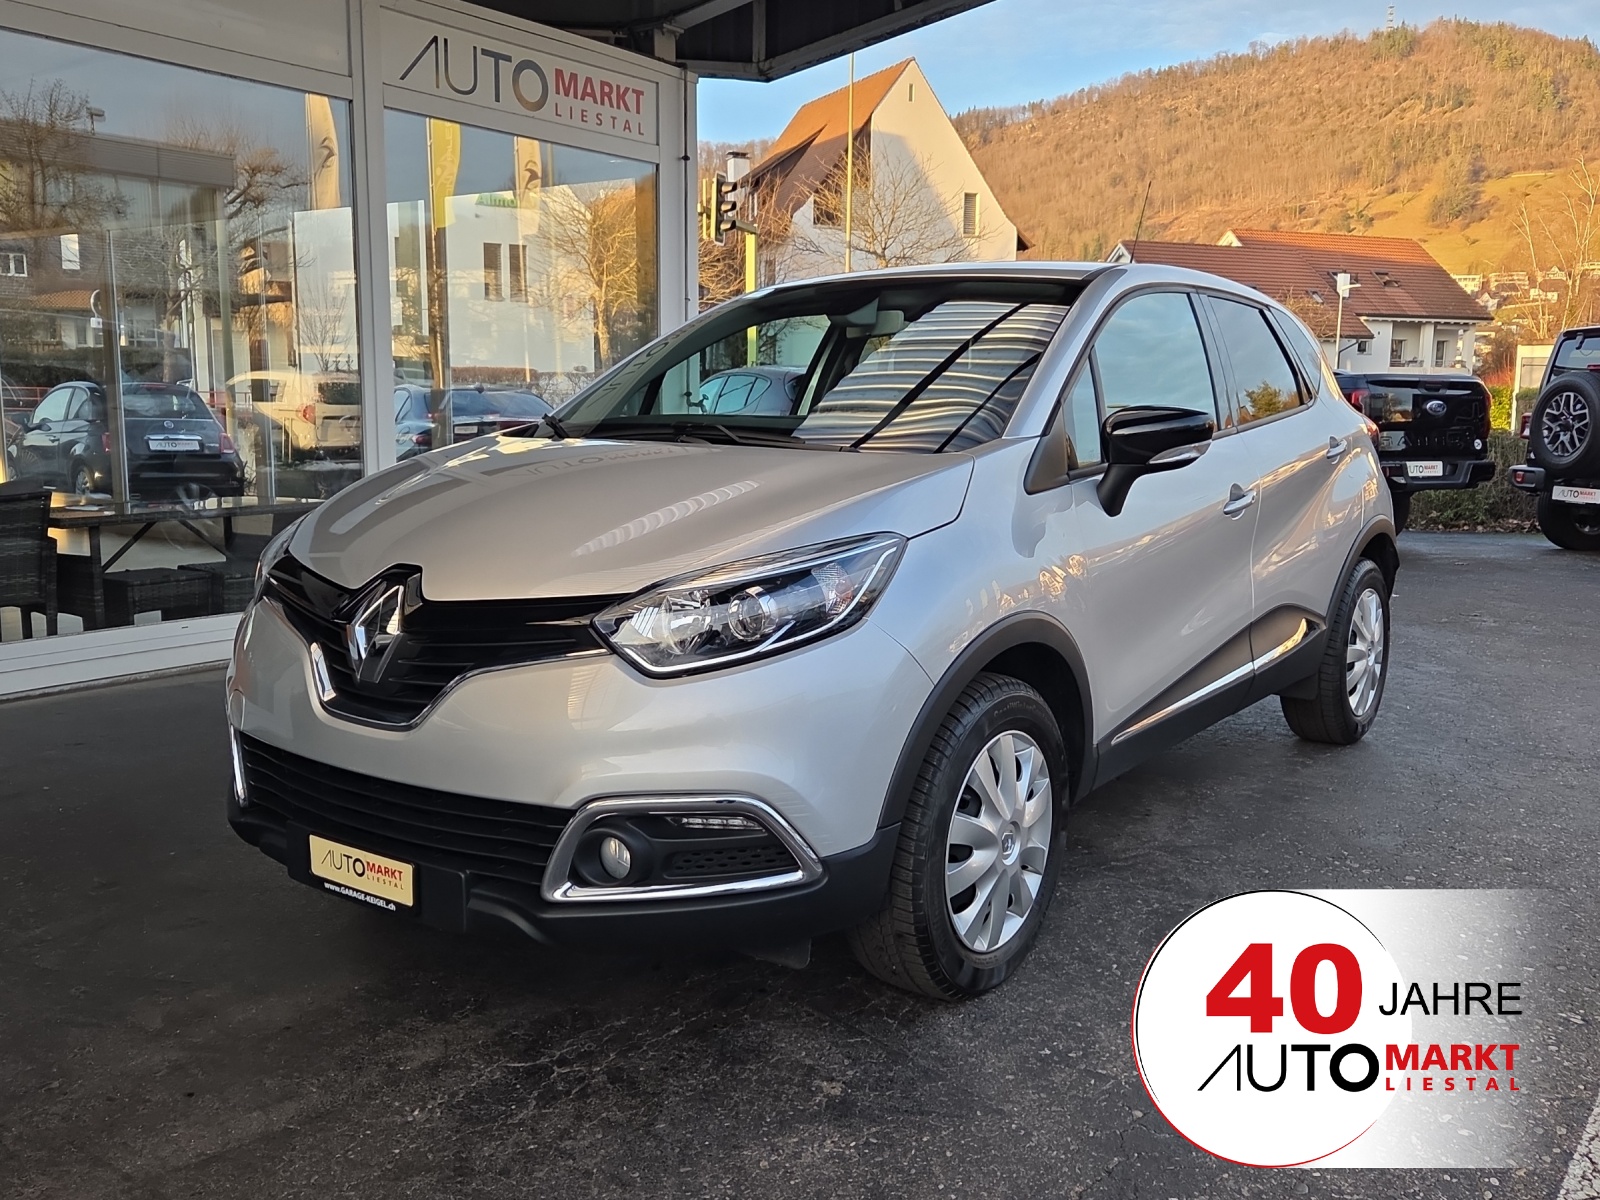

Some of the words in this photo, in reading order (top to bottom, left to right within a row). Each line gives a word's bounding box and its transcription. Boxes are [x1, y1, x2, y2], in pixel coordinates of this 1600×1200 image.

[555, 67, 644, 115] MARKT
[555, 102, 644, 136] LIESTAL
[1408, 464, 1424, 474] UTO
[365, 860, 404, 882] MARKT
[366, 875, 404, 891] LIESTAL
[324, 882, 396, 912] www.GARAGE-KEIGEL.ch
